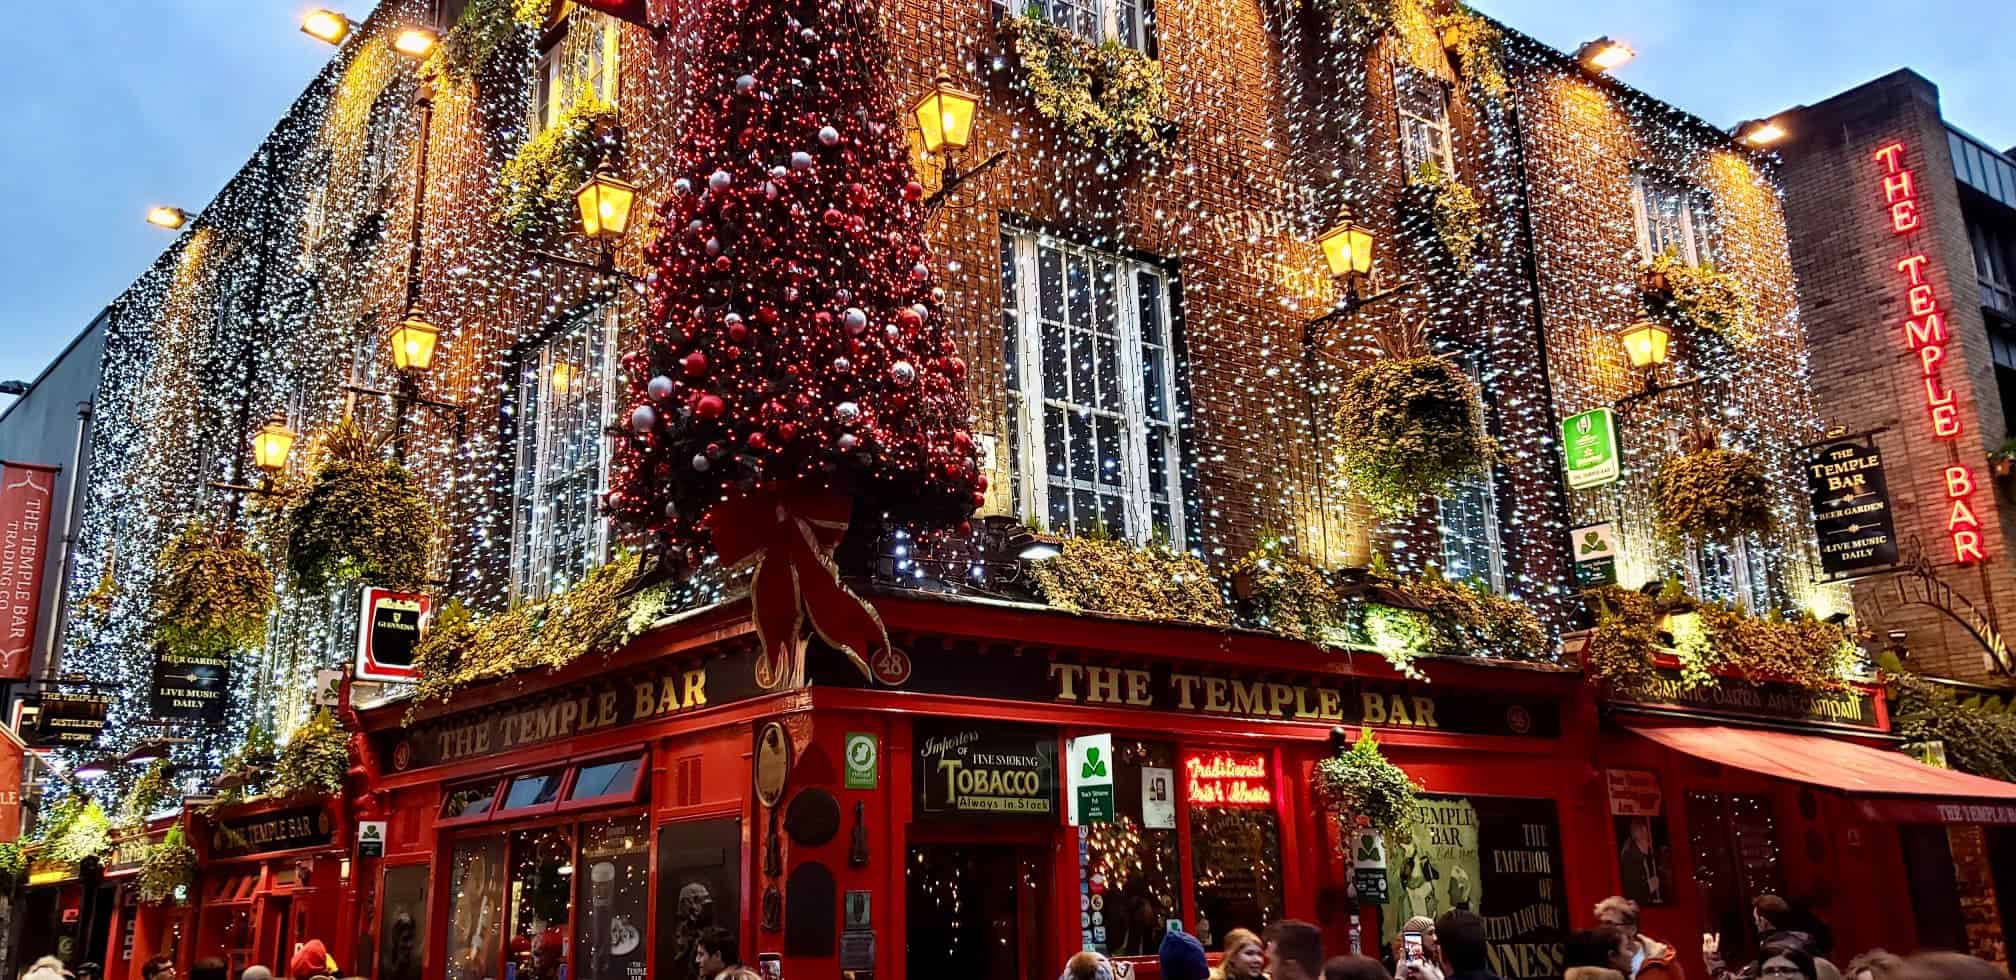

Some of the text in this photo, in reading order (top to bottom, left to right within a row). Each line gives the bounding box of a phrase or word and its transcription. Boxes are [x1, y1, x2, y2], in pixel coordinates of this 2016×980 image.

[1876, 144, 1983, 562] THE TEMPLE BAR
[1830, 448, 1854, 460] THE
[1810, 455, 1880, 478] TEMPLE
[1828, 474, 1866, 491] BAR
[1820, 502, 1884, 520] BEER GARDEN
[0, 520, 18, 587] TRADING
[1826, 536, 1887, 553] LIVE MUSIC
[1842, 548, 1873, 560] DAILY
[9, 499, 40, 639] THE TEMPLE BAR
[377, 621, 414, 631] GUINNESS
[187, 657, 226, 667] GARDEN
[42, 691, 62, 701] THE
[63, 693, 102, 703] TEMPLE
[160, 688, 219, 699] LIVE MUSIC
[173, 699, 205, 708] DAILY
[1050, 663, 1440, 728] THE TEMPLE BAR
[51, 718, 103, 728] DISTILLERY
[437, 724, 491, 761] THE
[502, 691, 618, 746] TEMPLE
[632, 669, 708, 719] BAR
[61, 732, 92, 741] STORE
[921, 730, 979, 759] Importers
[957, 747, 968, 755] OF
[973, 753, 1039, 767] FINE SMOKING
[1187, 757, 1265, 777] Traditional
[937, 760, 1040, 803] TOBACCO
[1188, 780, 1270, 803] Irish Music
[959, 799, 1049, 809] Always In Stock
[1937, 805, 1962, 821] THE
[1963, 805, 2006, 823] TEMPLE
[1416, 806, 1474, 826] EMPLE
[288, 815, 313, 838] BAR
[1431, 826, 1464, 847] BAR
[1522, 824, 1550, 847] THE
[1494, 850, 1552, 873] EMPEROR
[1482, 915, 1514, 941] LTED
[1486, 943, 1566, 980] NNESS
